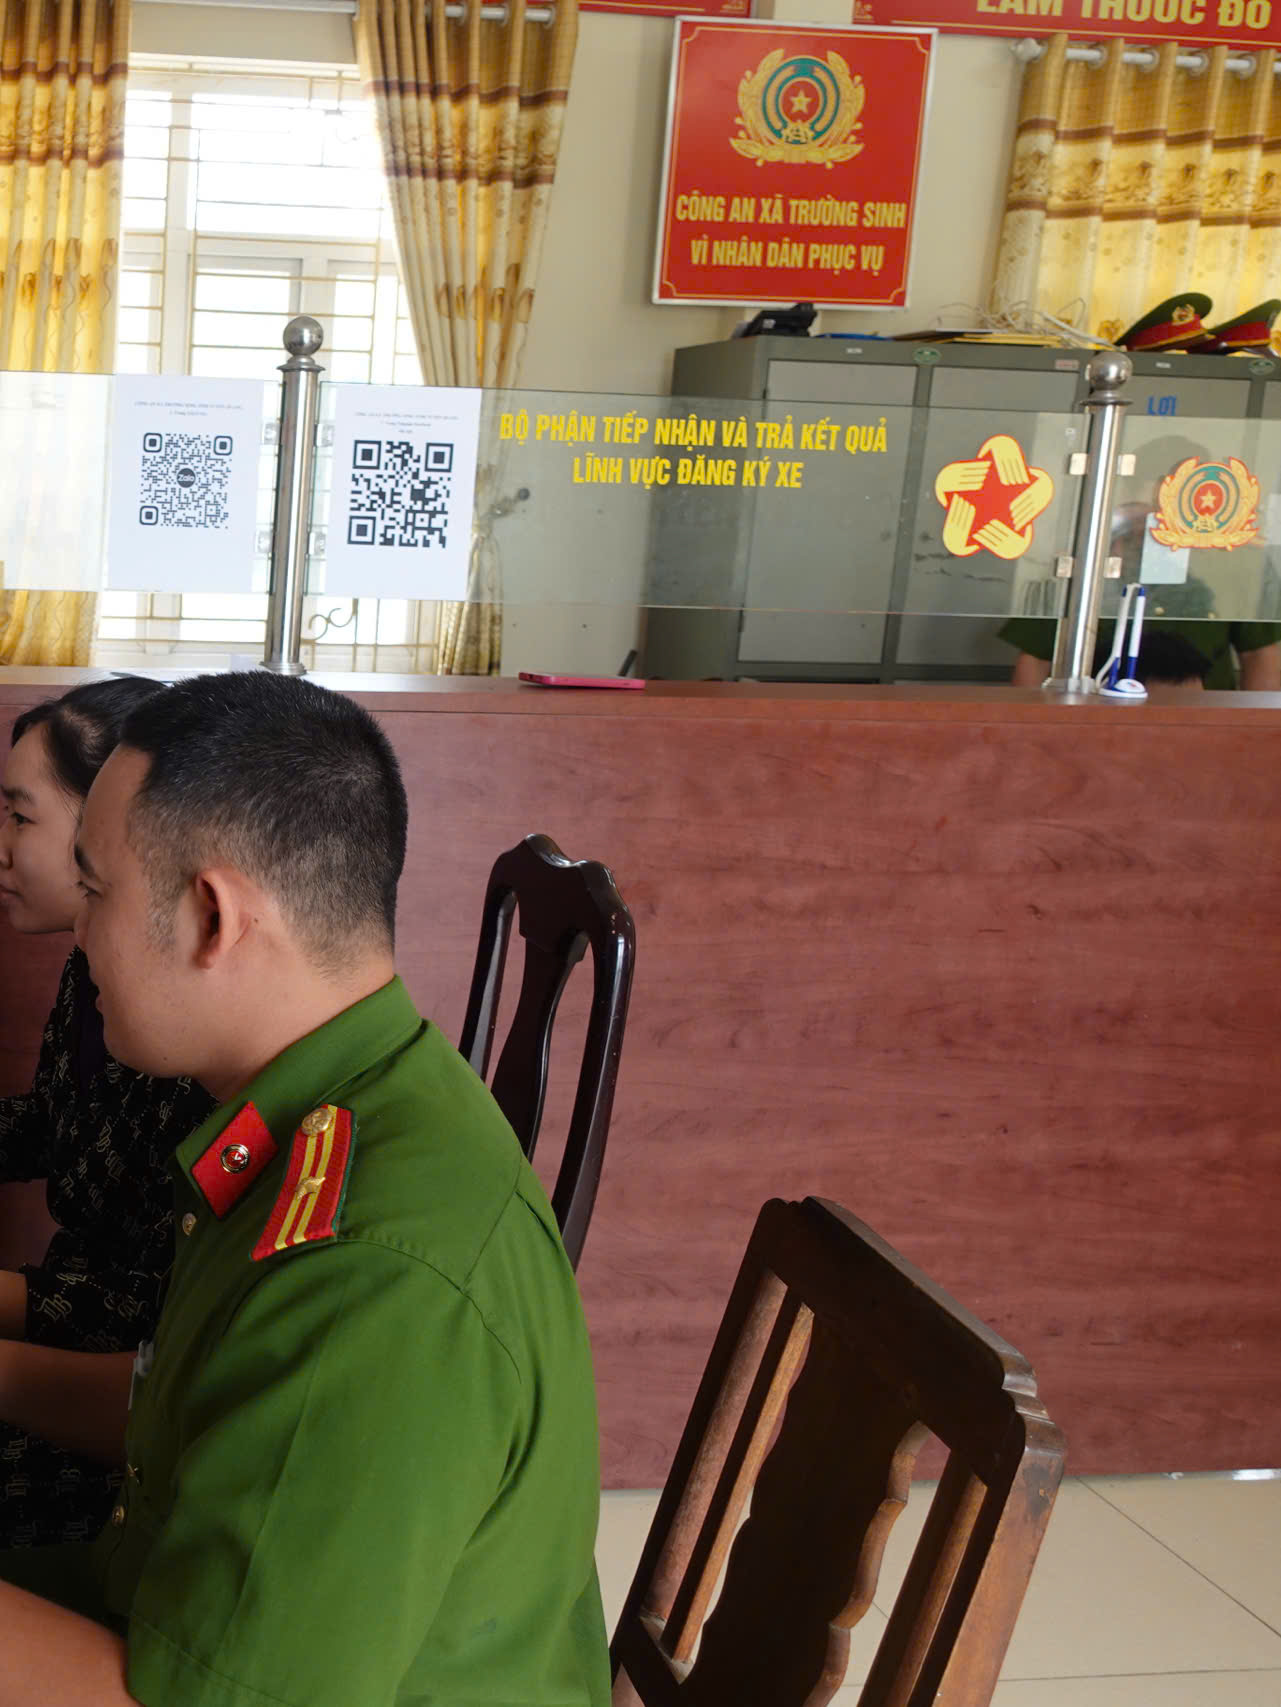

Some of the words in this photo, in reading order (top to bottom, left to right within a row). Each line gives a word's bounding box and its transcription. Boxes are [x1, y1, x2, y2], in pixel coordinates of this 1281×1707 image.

[675, 189, 726, 222] CÔNG
[728, 196, 754, 223] AN
[758, 193, 783, 225] XÃ
[789, 194, 858, 227] TRƯỜNG
[862, 201, 907, 228] SINH
[690, 233, 709, 265] VÌ
[712, 235, 762, 267] NHÂN
[766, 236, 804, 268] DÂN
[808, 243, 857, 275] PHỤC
[860, 244, 885, 276] VỤ
[499, 408, 529, 445] BỘ
[535, 409, 597, 446] PHẬN
[602, 410, 649, 444] TIẾP
[654, 413, 716, 451] NHẬN
[722, 416, 748, 448] VÀ
[756, 415, 794, 450] TRẢ
[800, 416, 841, 452] KẾT
[845, 417, 888, 453] QUẢ
[572, 452, 624, 484] LĨNH
[629, 455, 671, 489] VỰC
[676, 454, 736, 486] ĐĂNG
[742, 456, 772, 488] KÝ
[775, 461, 805, 489] XE
